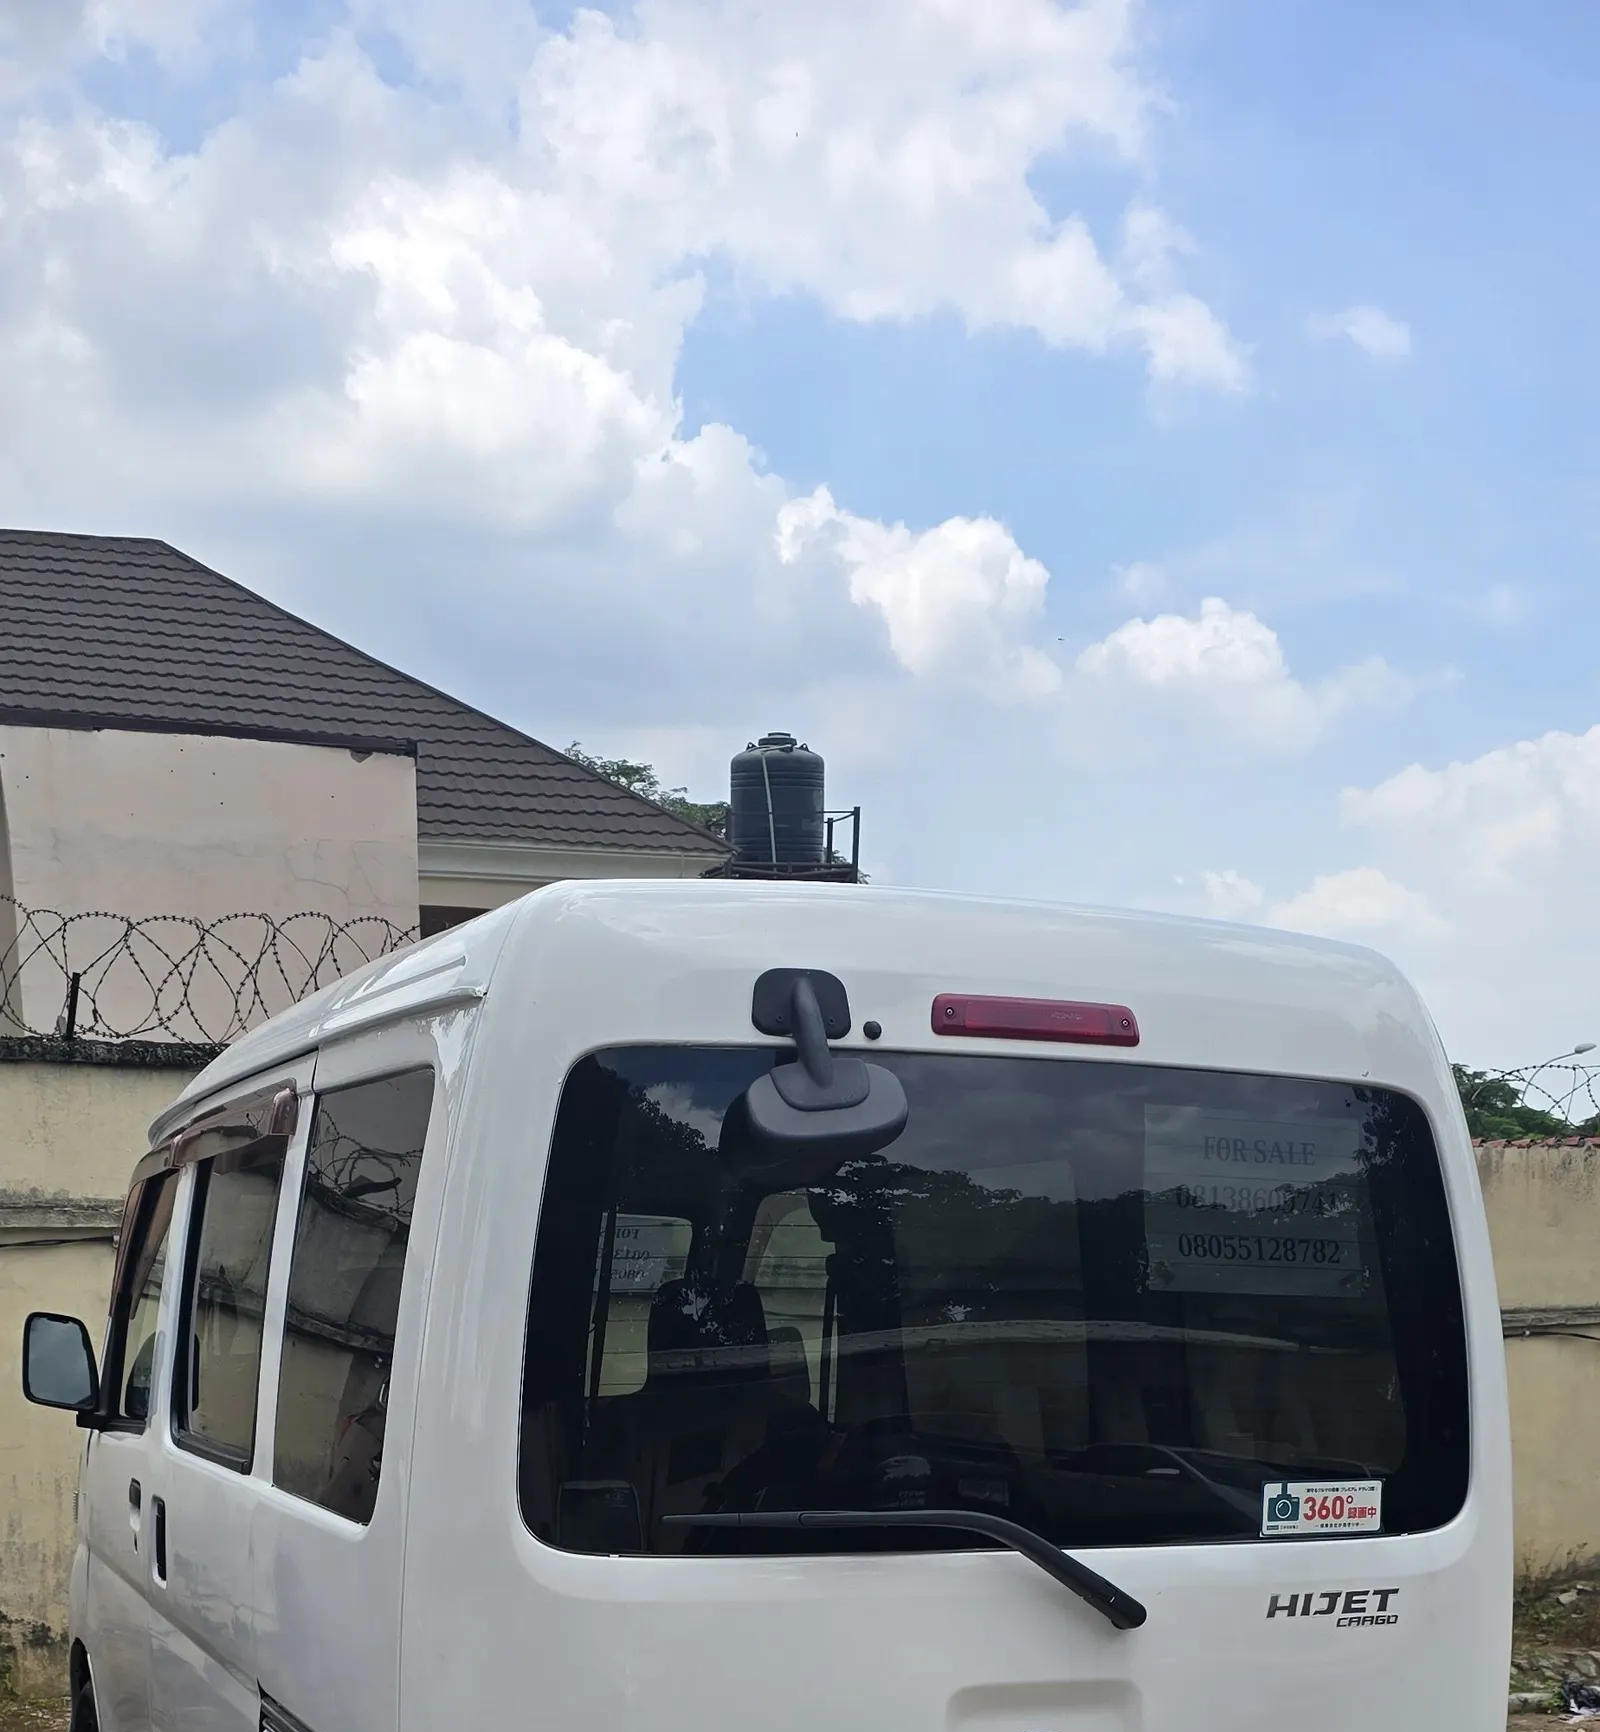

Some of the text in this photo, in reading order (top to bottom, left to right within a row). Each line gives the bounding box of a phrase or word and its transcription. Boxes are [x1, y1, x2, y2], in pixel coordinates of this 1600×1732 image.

[1202, 1136, 1316, 1166] FOR SALE
[1178, 1233, 1341, 1264] 08055128782
[1266, 1588, 1400, 1618] HIJET
[1336, 1614, 1399, 1628] CARGO
